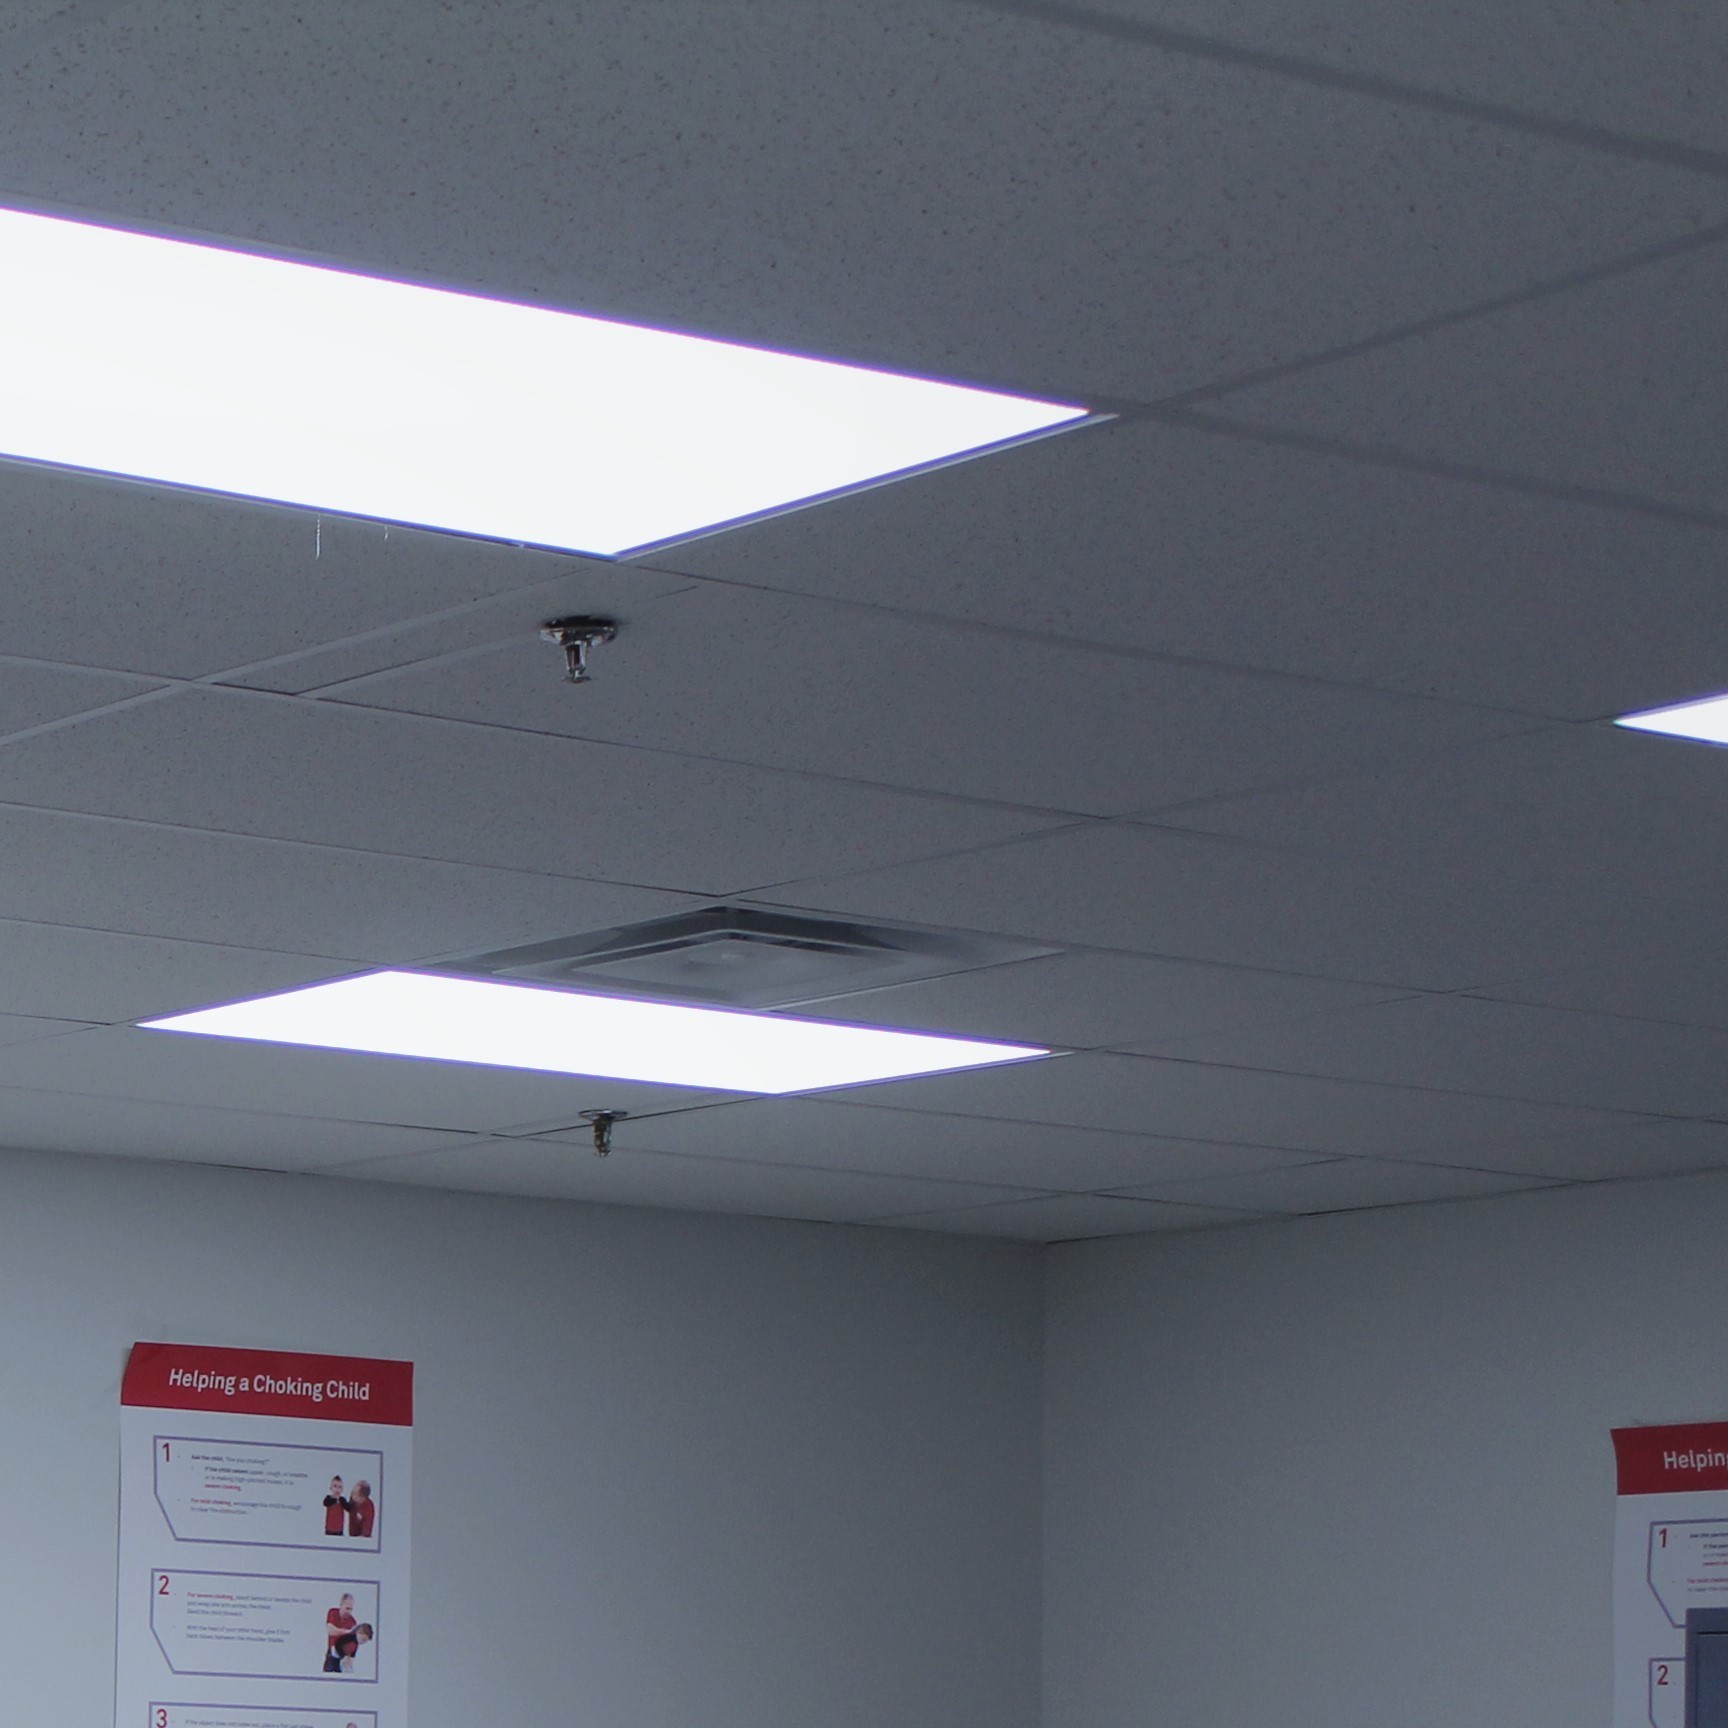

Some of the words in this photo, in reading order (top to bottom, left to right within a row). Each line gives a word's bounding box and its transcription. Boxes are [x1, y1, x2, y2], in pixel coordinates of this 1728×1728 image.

[169, 1368, 235, 1395] Helping
[240, 1377, 249, 1391] a
[253, 1374, 323, 1402] Choking
[326, 1380, 370, 1401] Child
[163, 1443, 170, 1462] 1
[1664, 1449, 1728, 1471] Helpin
[1659, 1528, 1668, 1548] 1
[158, 1575, 169, 1596] 2
[1657, 1665, 1669, 1687] 2
[156, 1709, 168, 1728] 3
